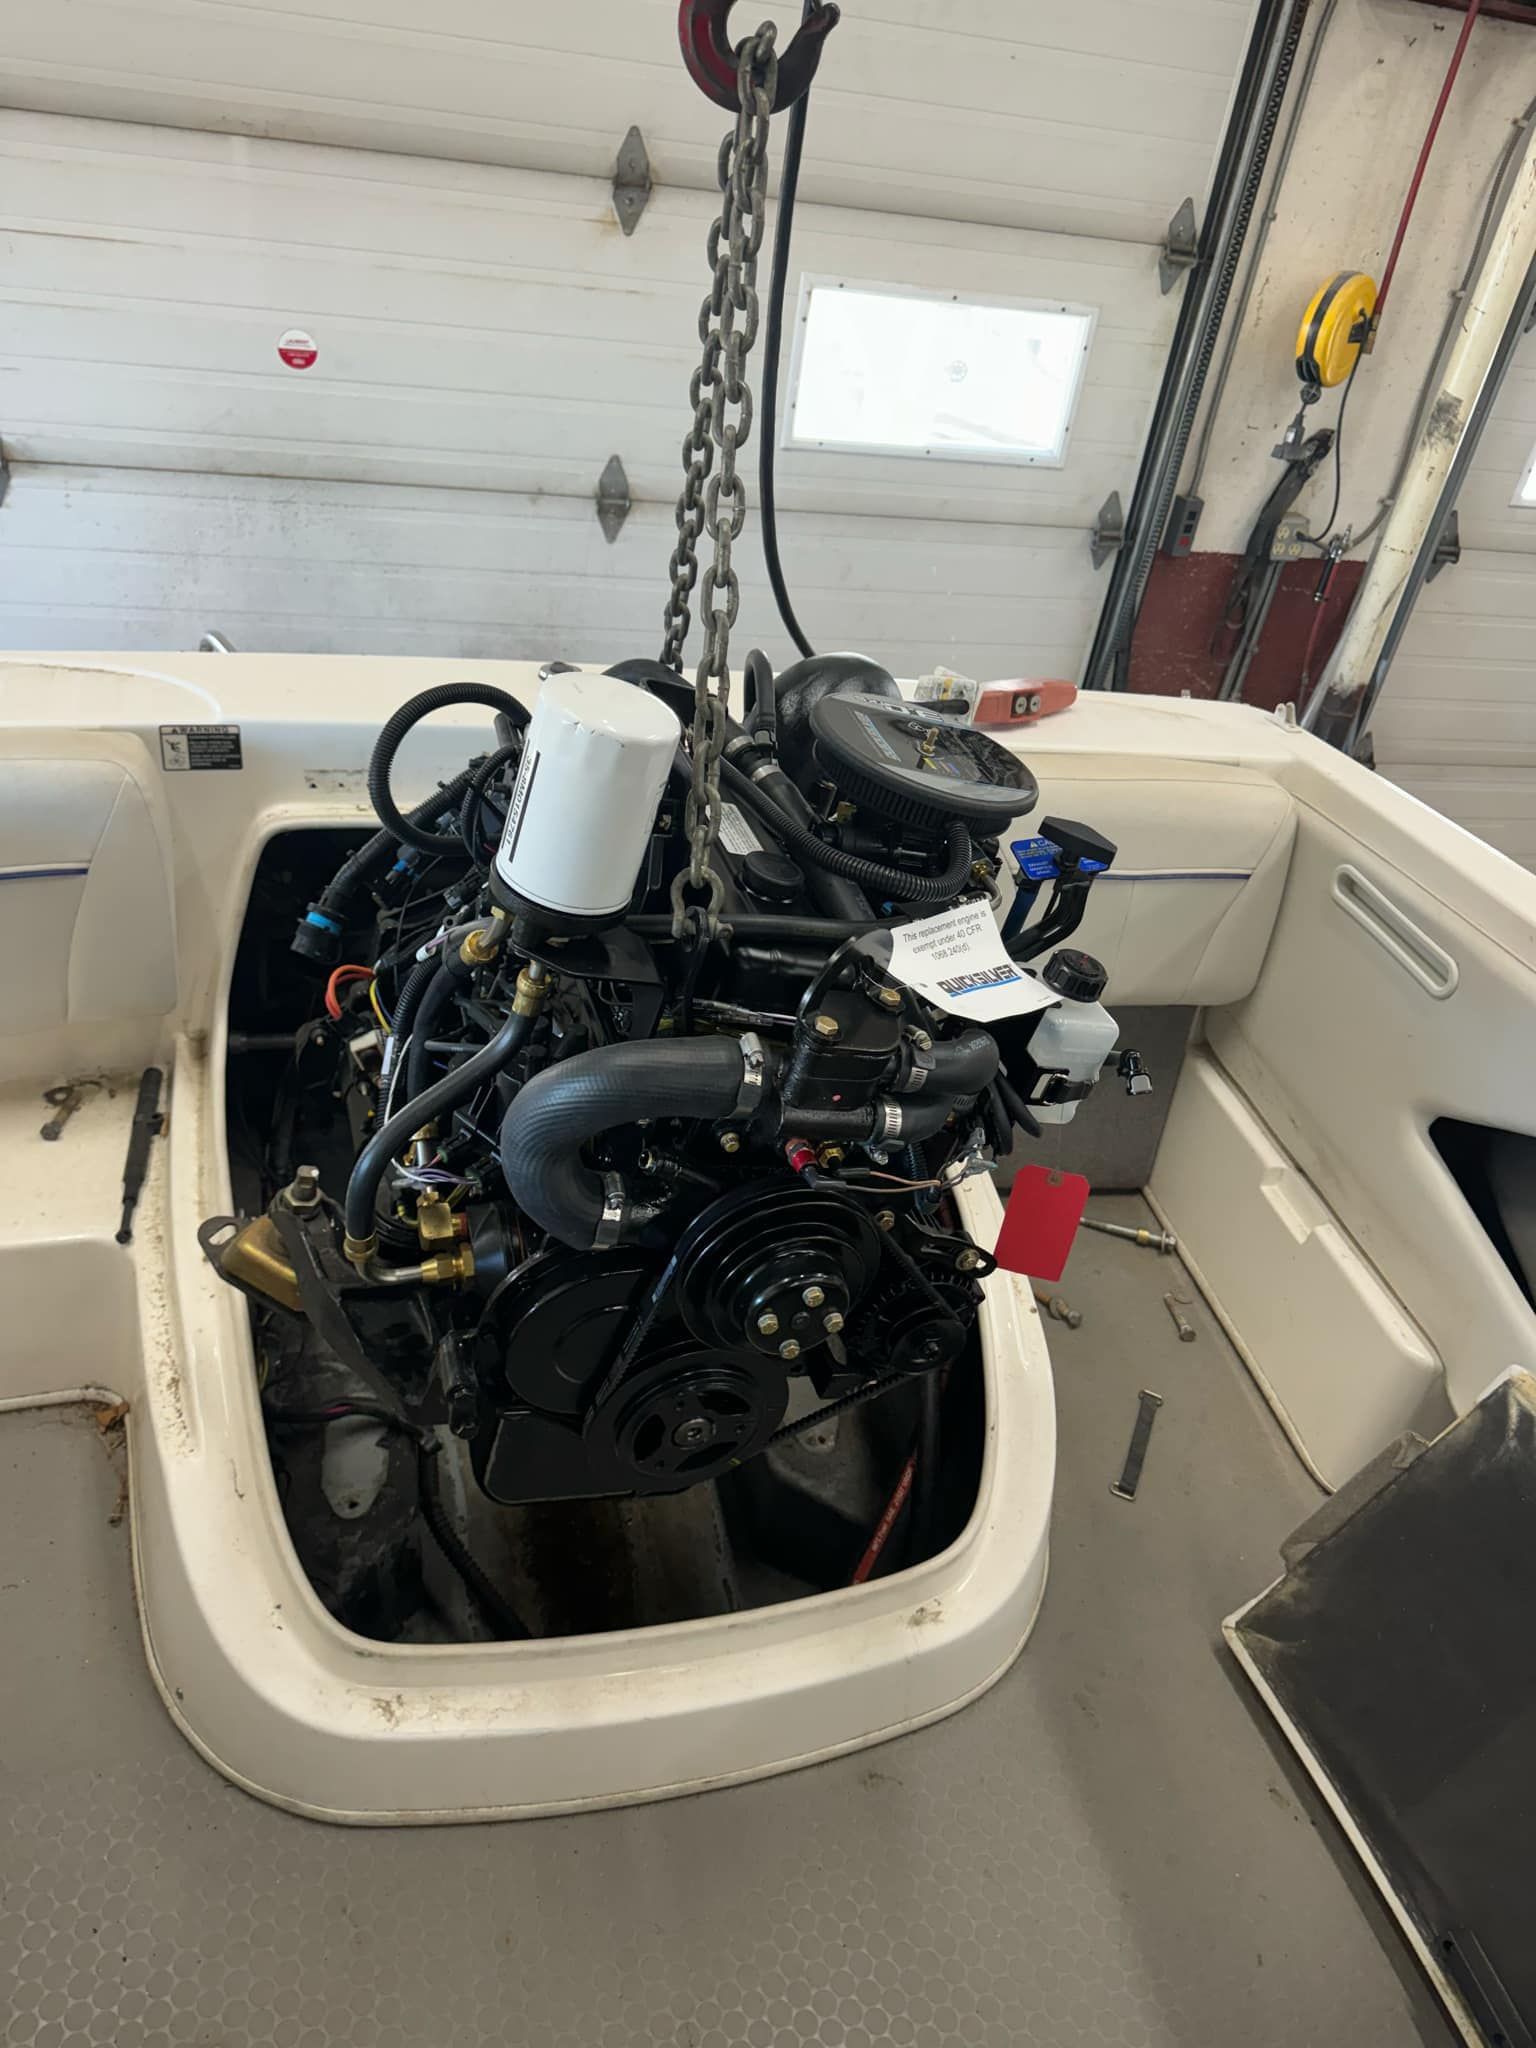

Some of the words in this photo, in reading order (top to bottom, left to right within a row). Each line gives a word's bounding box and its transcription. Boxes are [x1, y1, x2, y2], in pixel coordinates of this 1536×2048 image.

[902, 931, 917, 943] This
[918, 919, 957, 938] replacement
[957, 912, 980, 925] engine
[980, 910, 987, 918] is
[912, 939, 937, 954] exempt
[937, 933, 956, 946] under
[956, 928, 966, 939] 40
[965, 922, 983, 936] CFR
[936, 964, 1019, 995] QUICKSILVER
